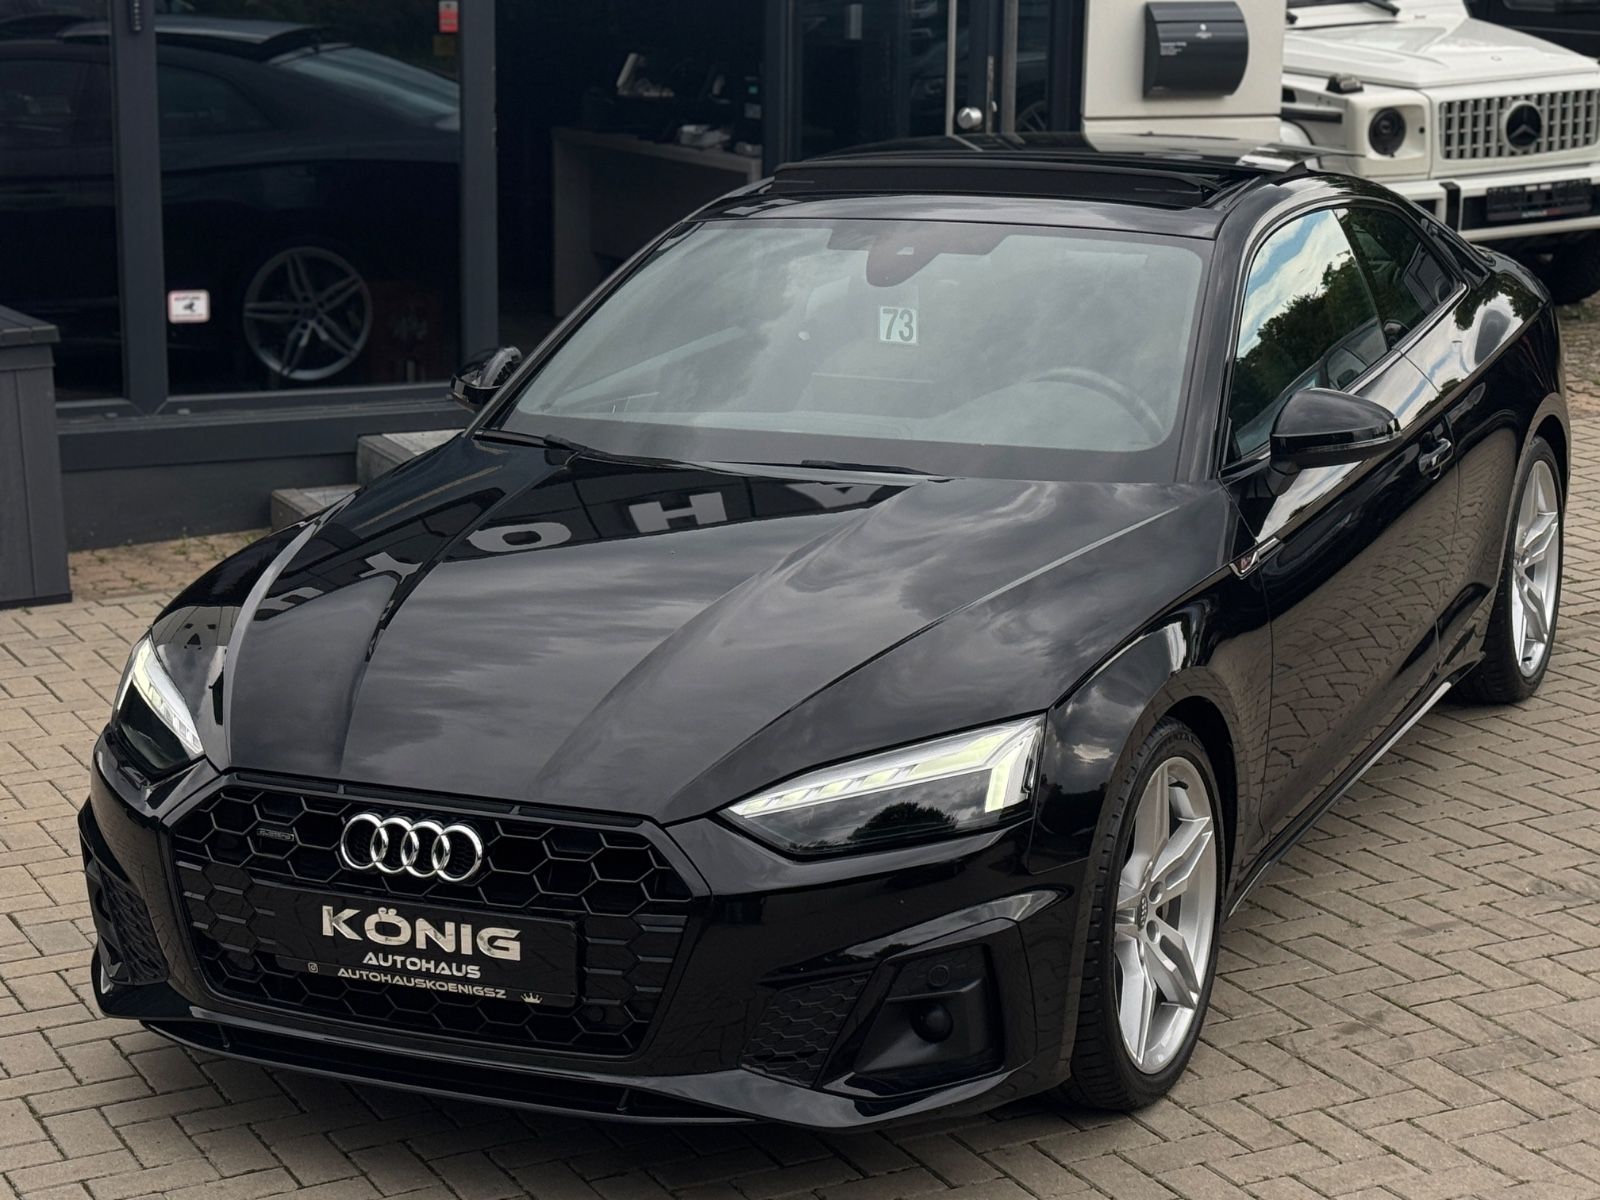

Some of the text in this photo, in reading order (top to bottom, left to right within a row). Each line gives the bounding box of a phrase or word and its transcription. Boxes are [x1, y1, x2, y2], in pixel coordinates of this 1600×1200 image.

[882, 308, 914, 342] 73
[322, 905, 521, 961] KÖNIG
[362, 951, 481, 979] AUTOHAUS
[337, 967, 507, 999] AUTOHAUSKOENIGSZ
